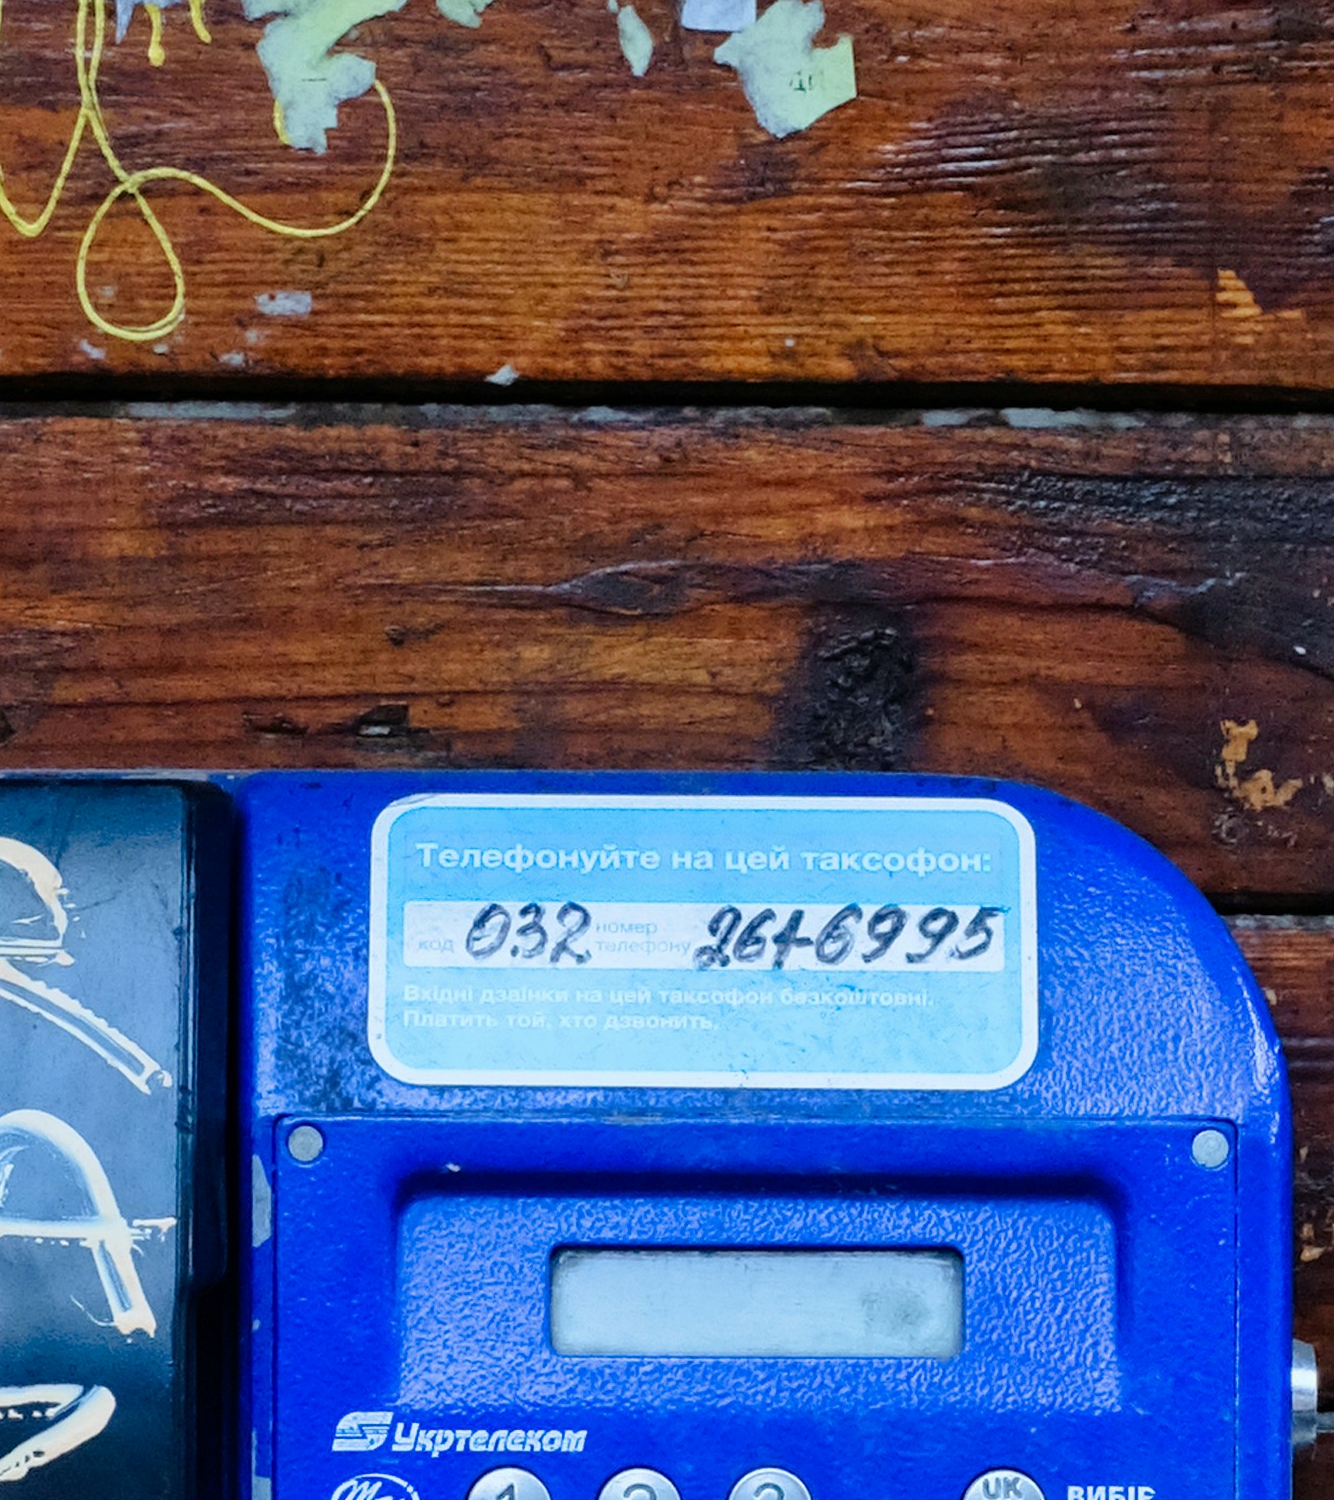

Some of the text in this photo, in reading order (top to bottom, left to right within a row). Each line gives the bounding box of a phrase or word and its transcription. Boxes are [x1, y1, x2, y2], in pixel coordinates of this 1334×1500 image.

[415, 842, 992, 877] Телефонуйте на цей таксофон:
[595, 921, 658, 936] номер
[417, 937, 455, 954] код
[595, 939, 692, 956] телефону
[403, 984, 474, 1005] Вхідні
[479, 985, 568, 1006] дзвінки
[575, 989, 603, 1003] на
[609, 985, 653, 1007] цей
[658, 988, 773, 1010] таксофон
[559, 1016, 598, 1030] хто
[391, 1422, 588, 1458] Укртелеком
[982, 1477, 1023, 1500] UK
